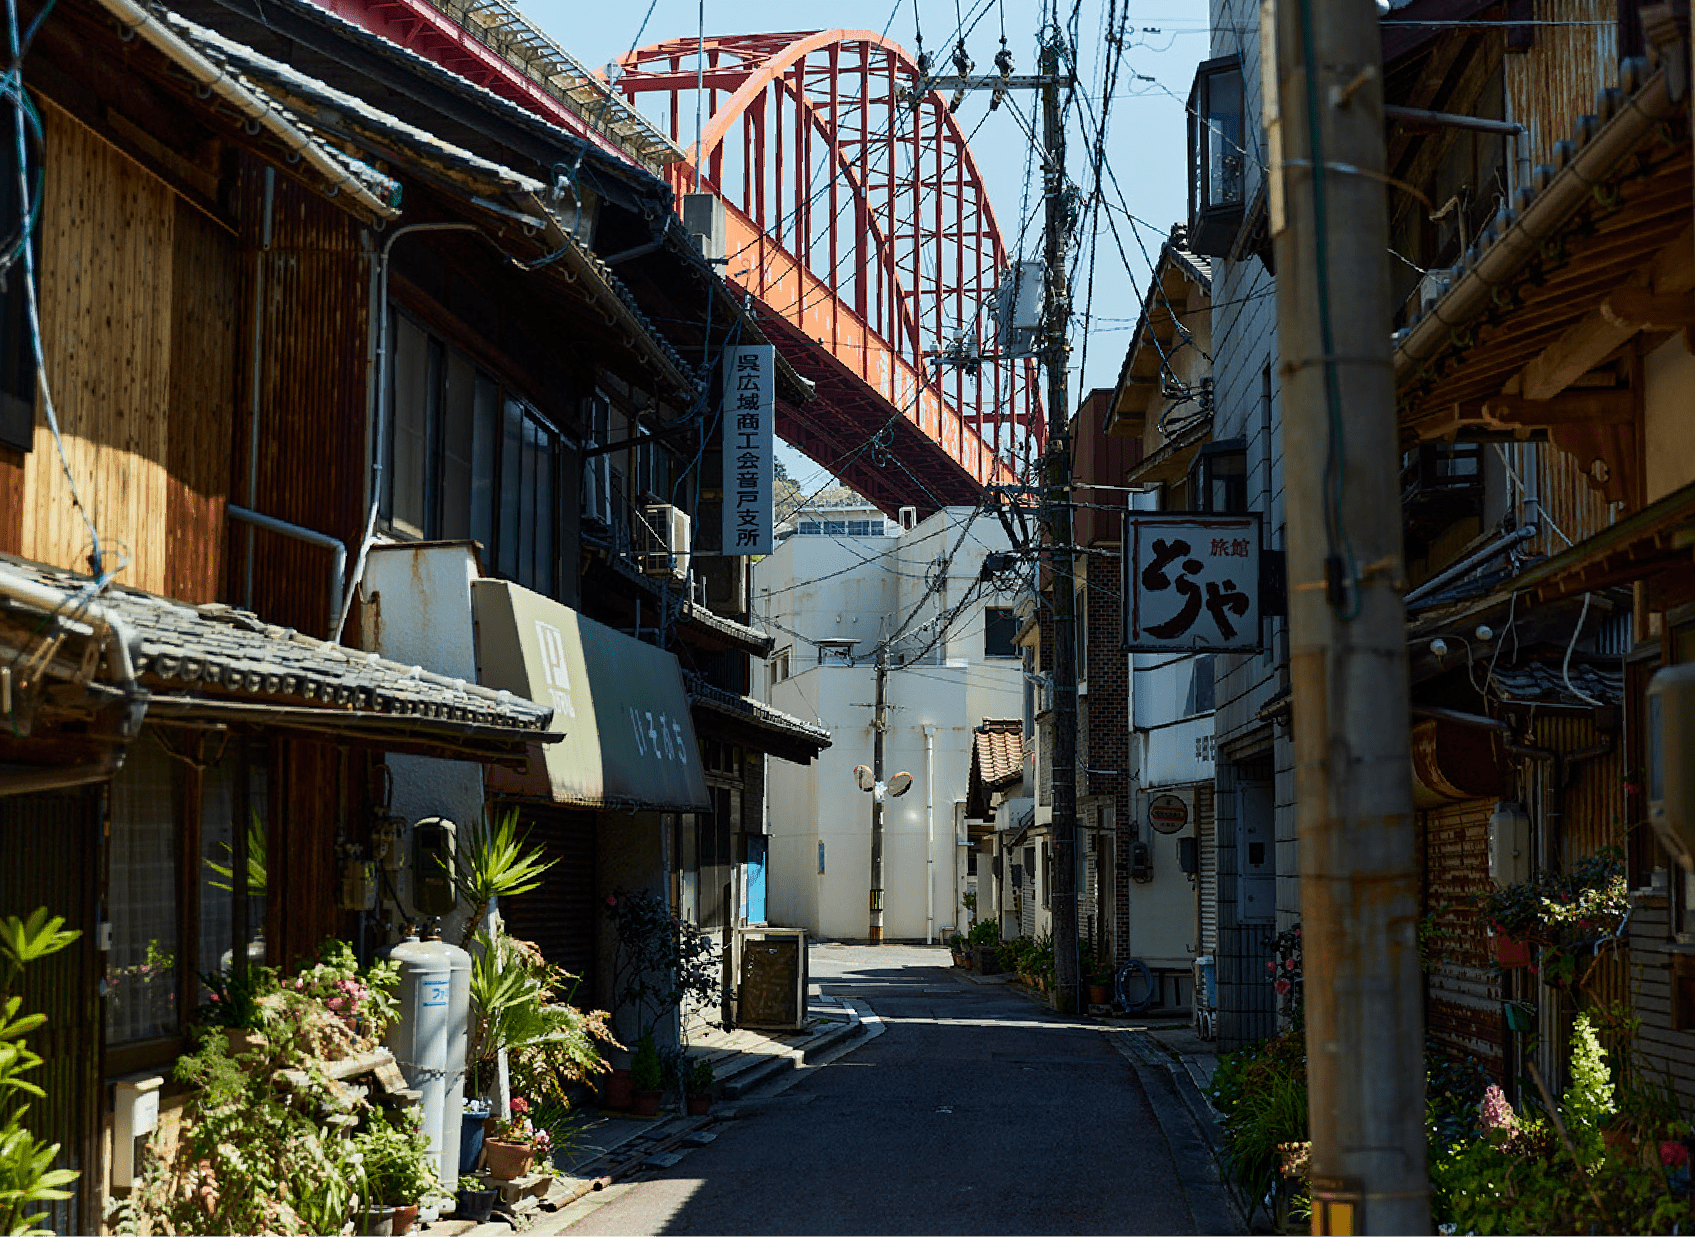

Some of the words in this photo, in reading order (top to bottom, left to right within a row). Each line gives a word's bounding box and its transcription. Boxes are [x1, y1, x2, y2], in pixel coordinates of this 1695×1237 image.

[736, 354, 760, 547] 呉広域商工会音戸支所
[1142, 538, 1250, 641] とらや
[1210, 538, 1250, 557] 旅館
